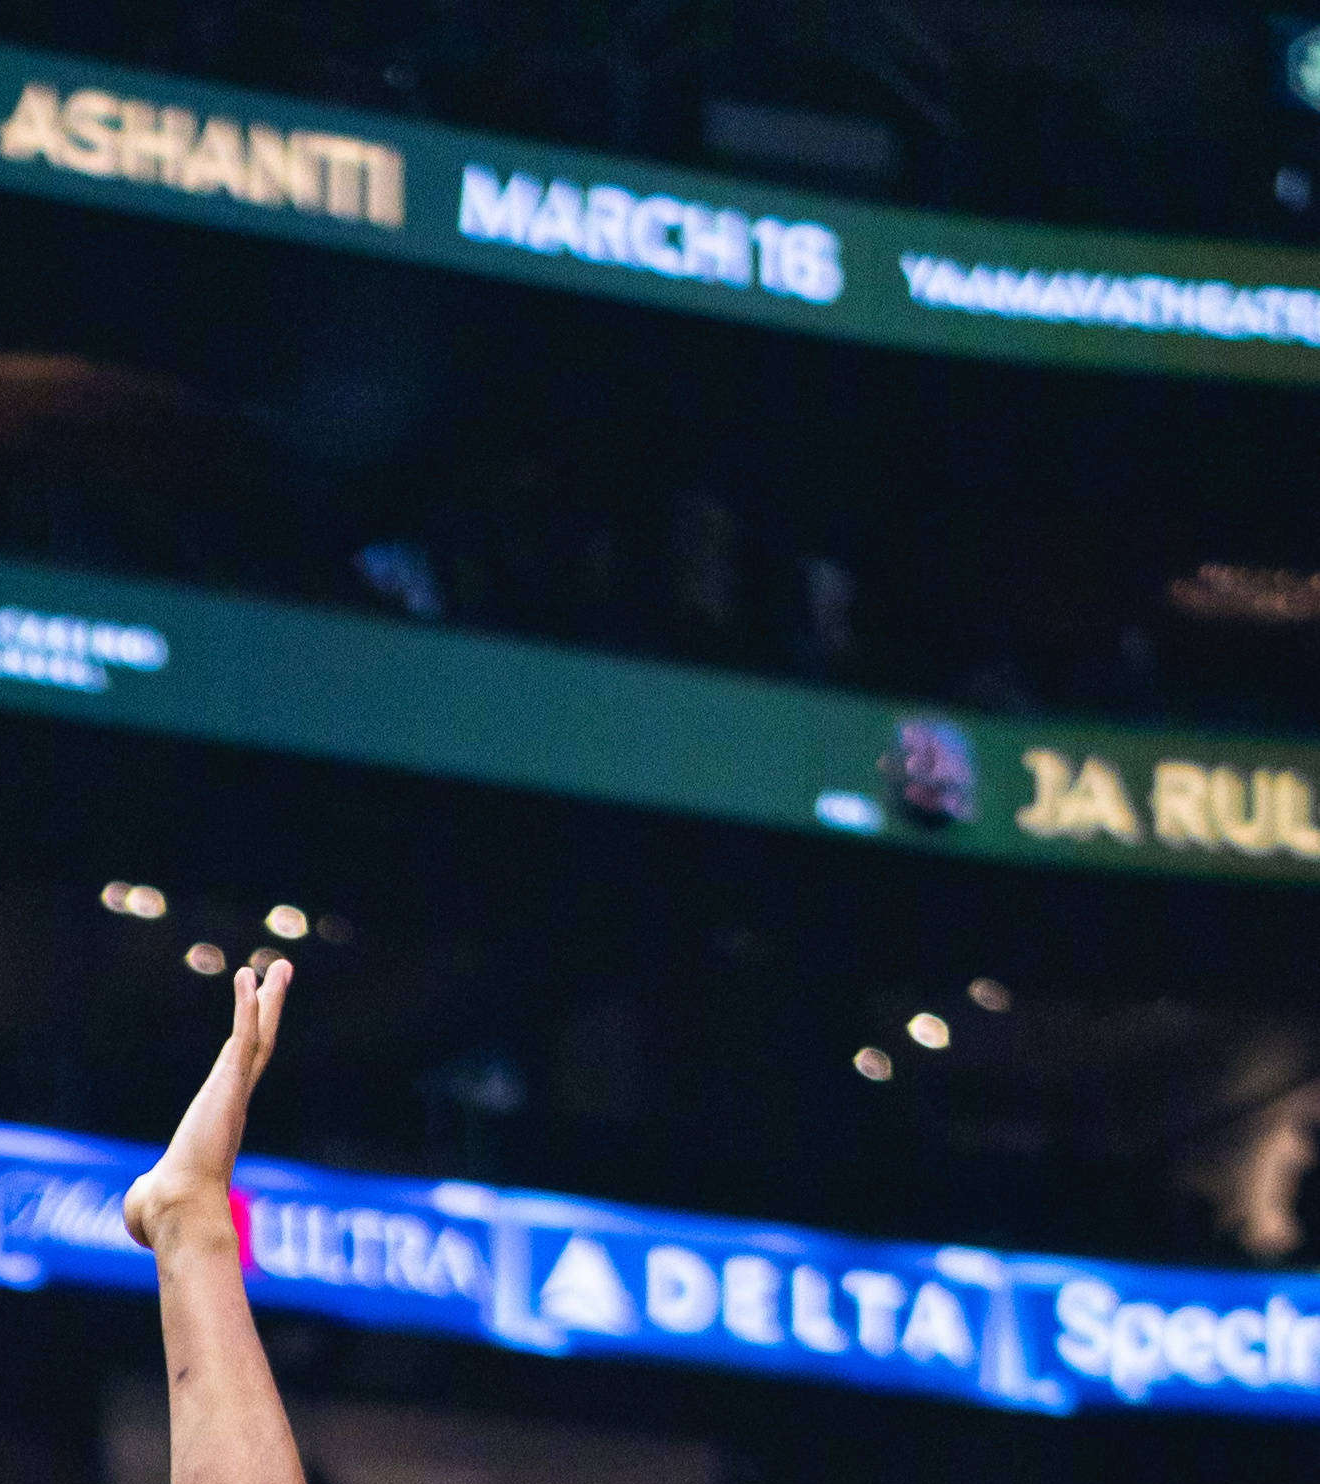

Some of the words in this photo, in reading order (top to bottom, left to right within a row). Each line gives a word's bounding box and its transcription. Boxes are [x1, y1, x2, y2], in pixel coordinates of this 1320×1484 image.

[459, 163, 748, 290] MARCH
[751, 215, 842, 305] 16
[1016, 748, 1141, 845] JA
[252, 1198, 493, 1298] ULTRA
[645, 1245, 976, 1365] DELTA
